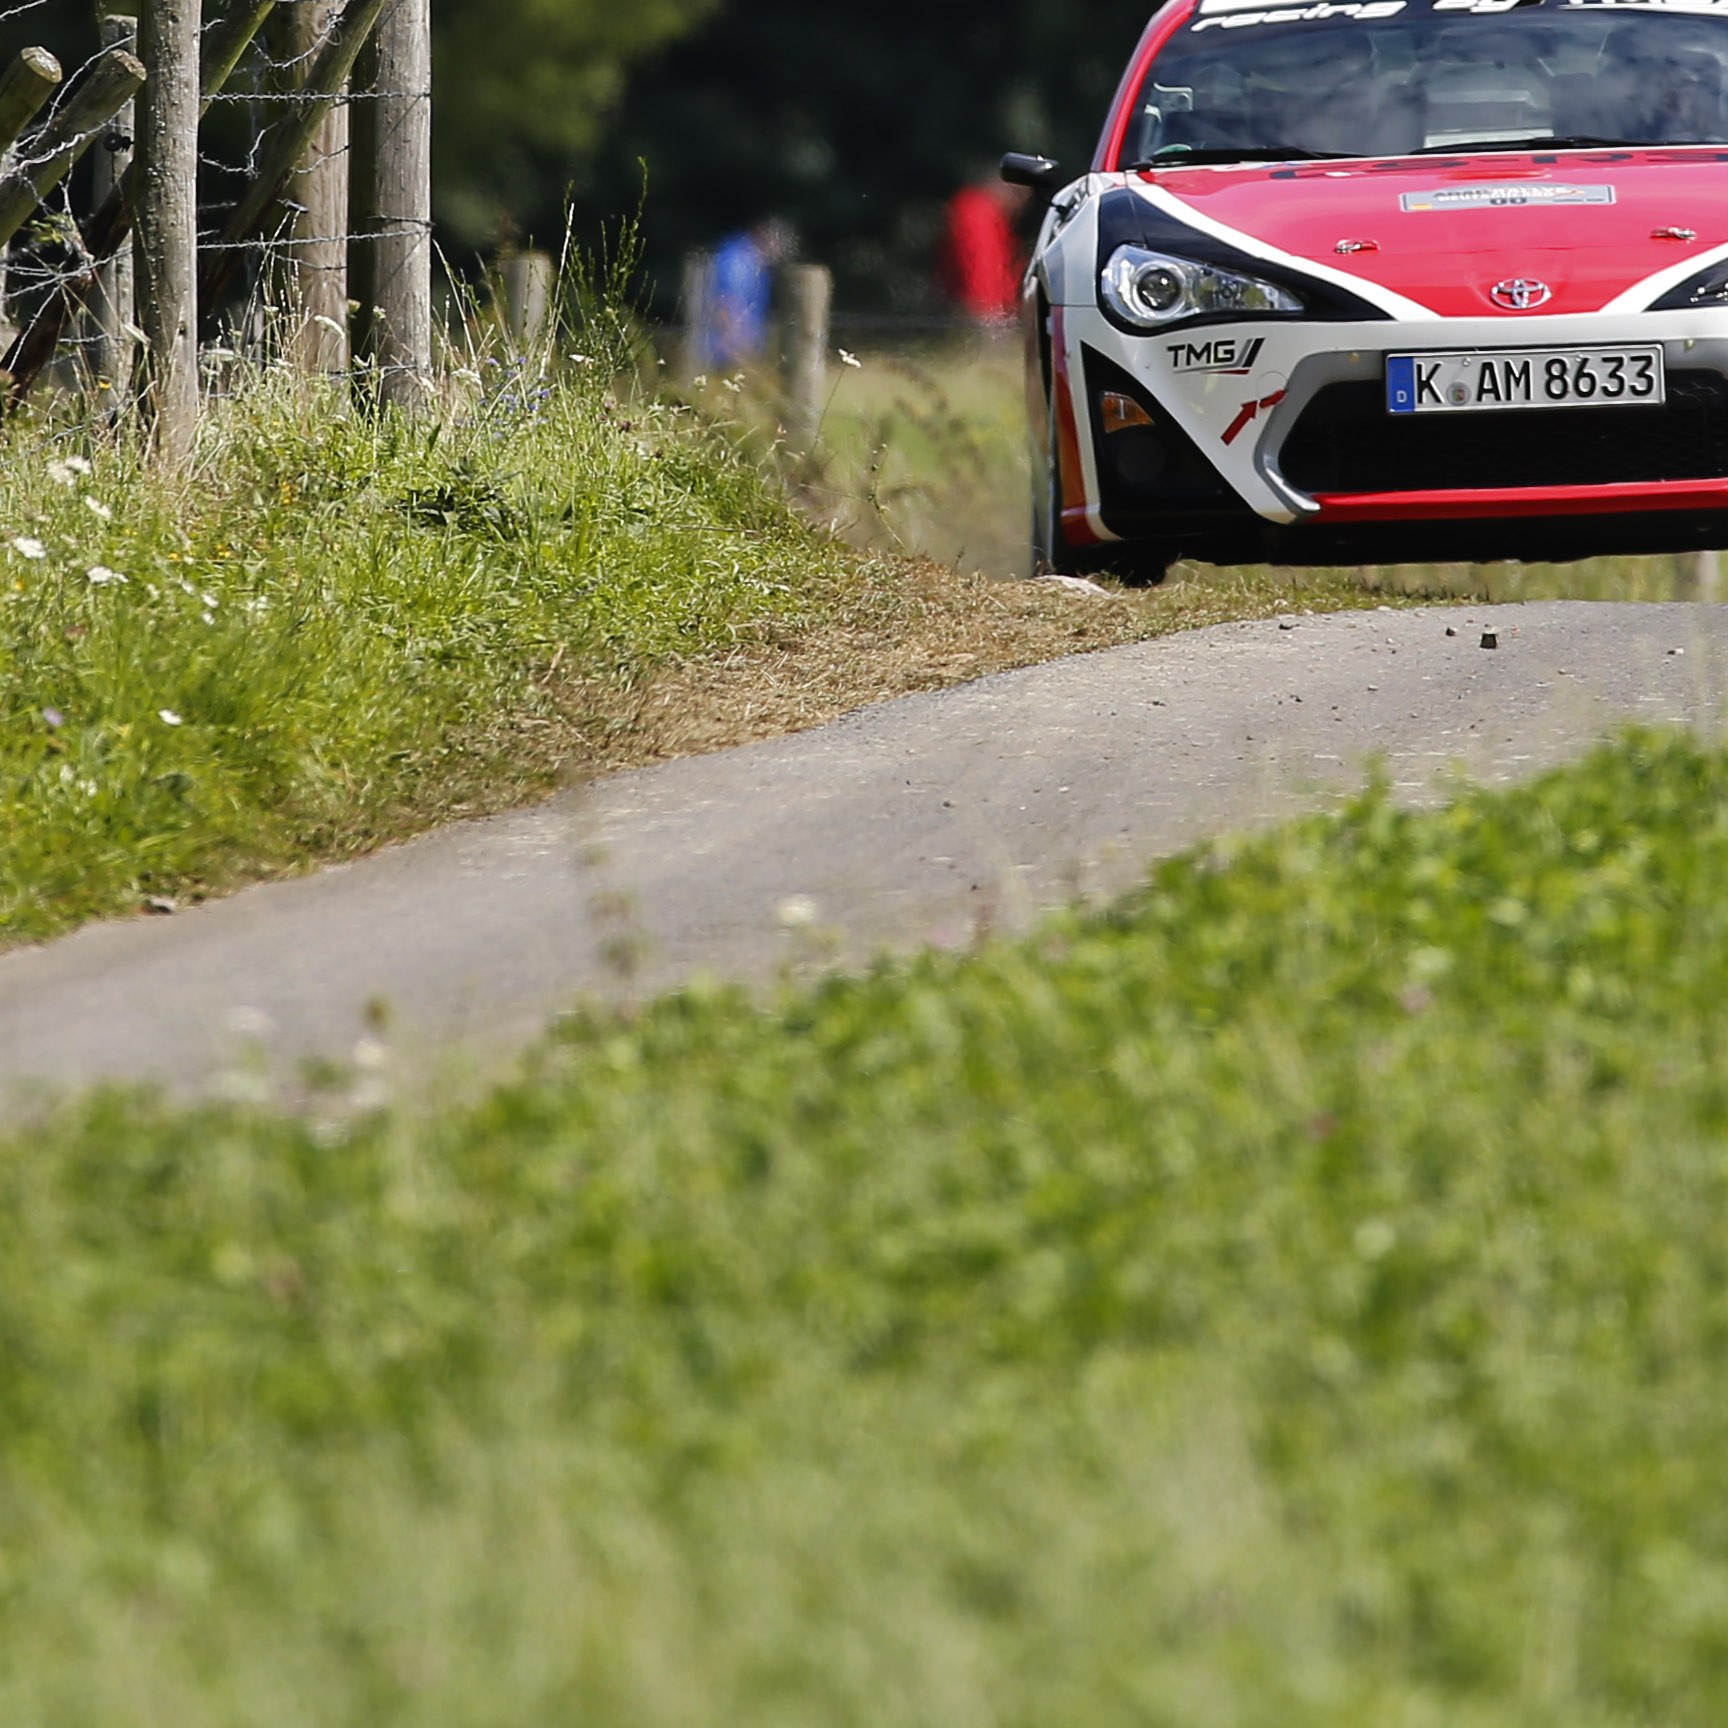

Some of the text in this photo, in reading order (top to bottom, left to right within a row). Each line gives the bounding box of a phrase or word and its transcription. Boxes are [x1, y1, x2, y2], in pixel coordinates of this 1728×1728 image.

[1190, 0, 1408, 32] racing
[1167, 340, 1235, 367] TMG
[1396, 355, 1655, 404] D K AM 8633
